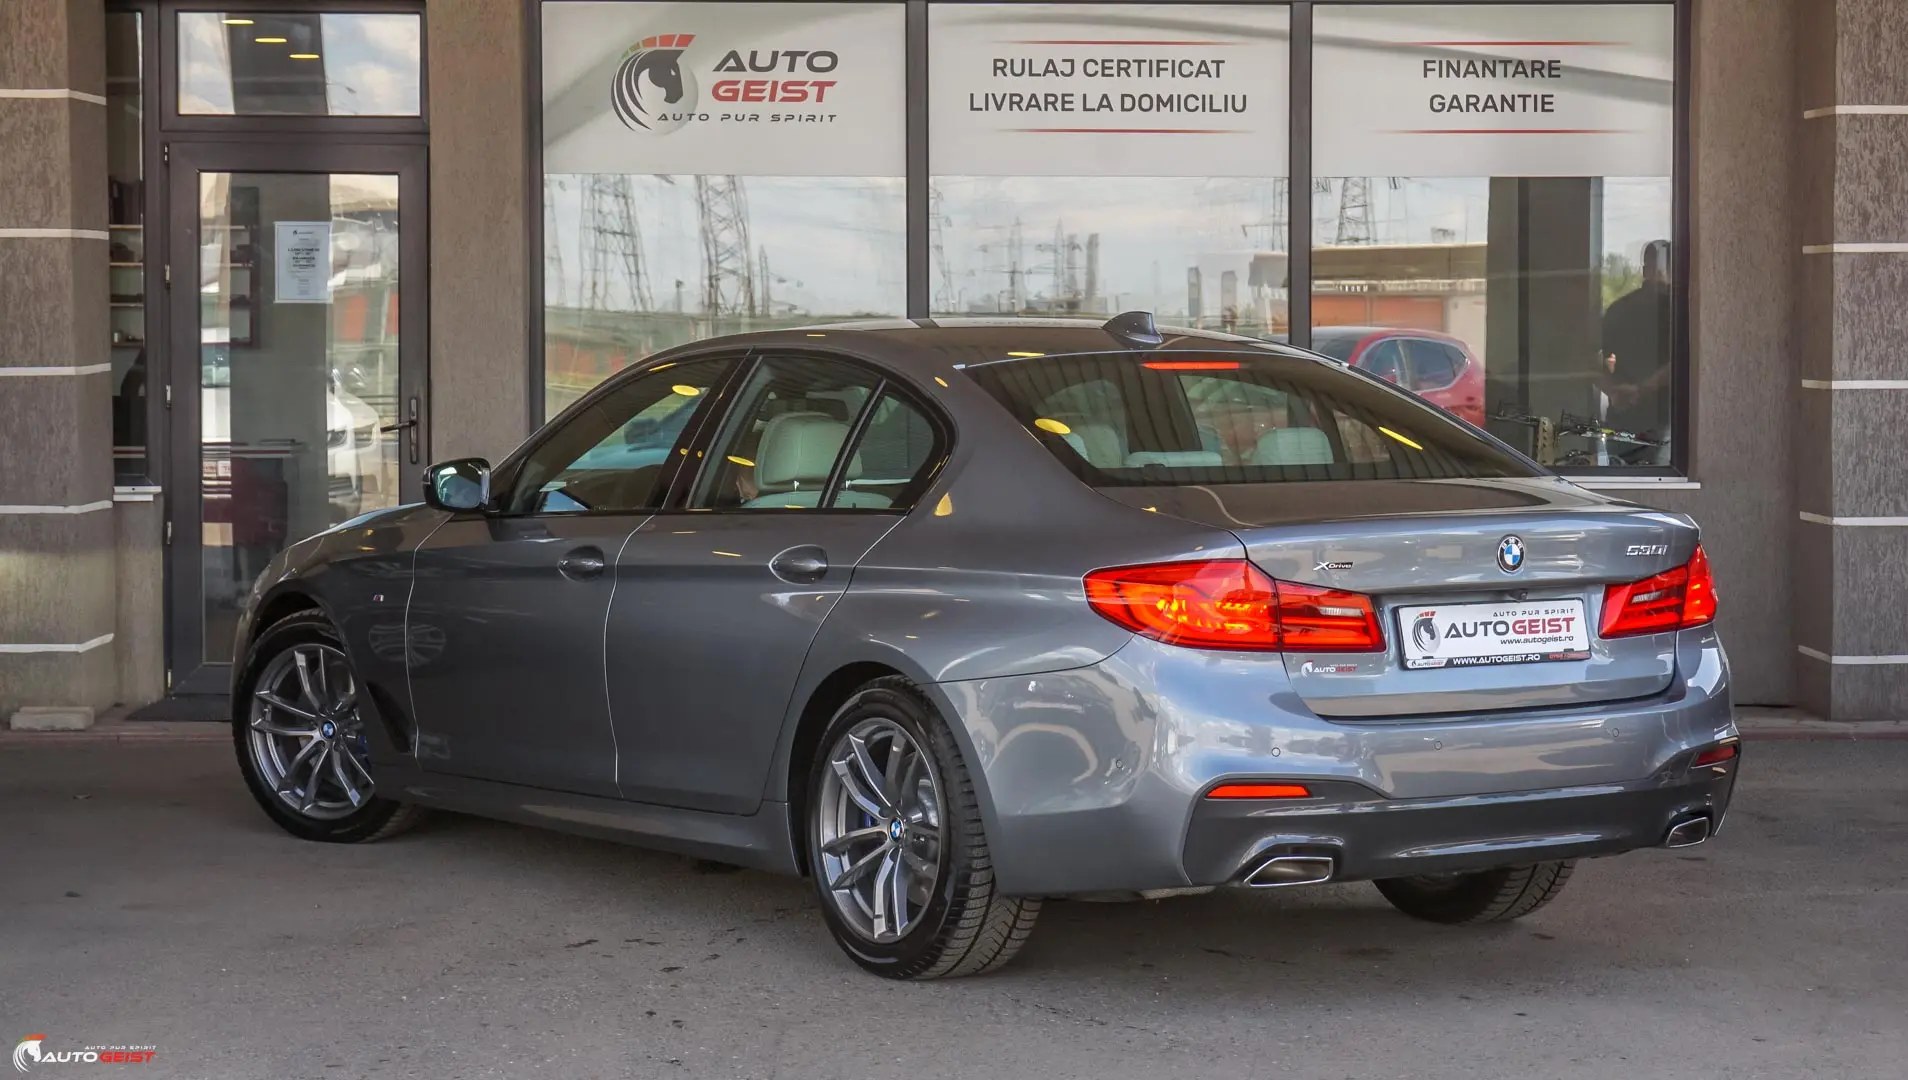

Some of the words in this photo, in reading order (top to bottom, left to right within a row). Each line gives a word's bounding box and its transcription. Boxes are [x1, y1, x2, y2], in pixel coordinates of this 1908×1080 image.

[712, 49, 839, 73] AUTO
[992, 58, 1075, 77] RULAJ
[1082, 58, 1226, 78] CERTIFICAT
[1423, 59, 1561, 79] FINANTARE
[711, 79, 838, 103] GEIST
[969, 92, 1075, 112] LIVRARE
[1082, 93, 1114, 112] LA
[1120, 93, 1247, 113] DOMICILIU
[1429, 94, 1555, 113] GARANTIE
[657, 112, 710, 122] AUTO
[720, 113, 760, 122] PUR
[770, 113, 837, 123] SPIRIT
[1500, 635, 1574, 645] www.autogeist.ro
[1453, 653, 1541, 666] WWW.AUTOGEIST.RO
